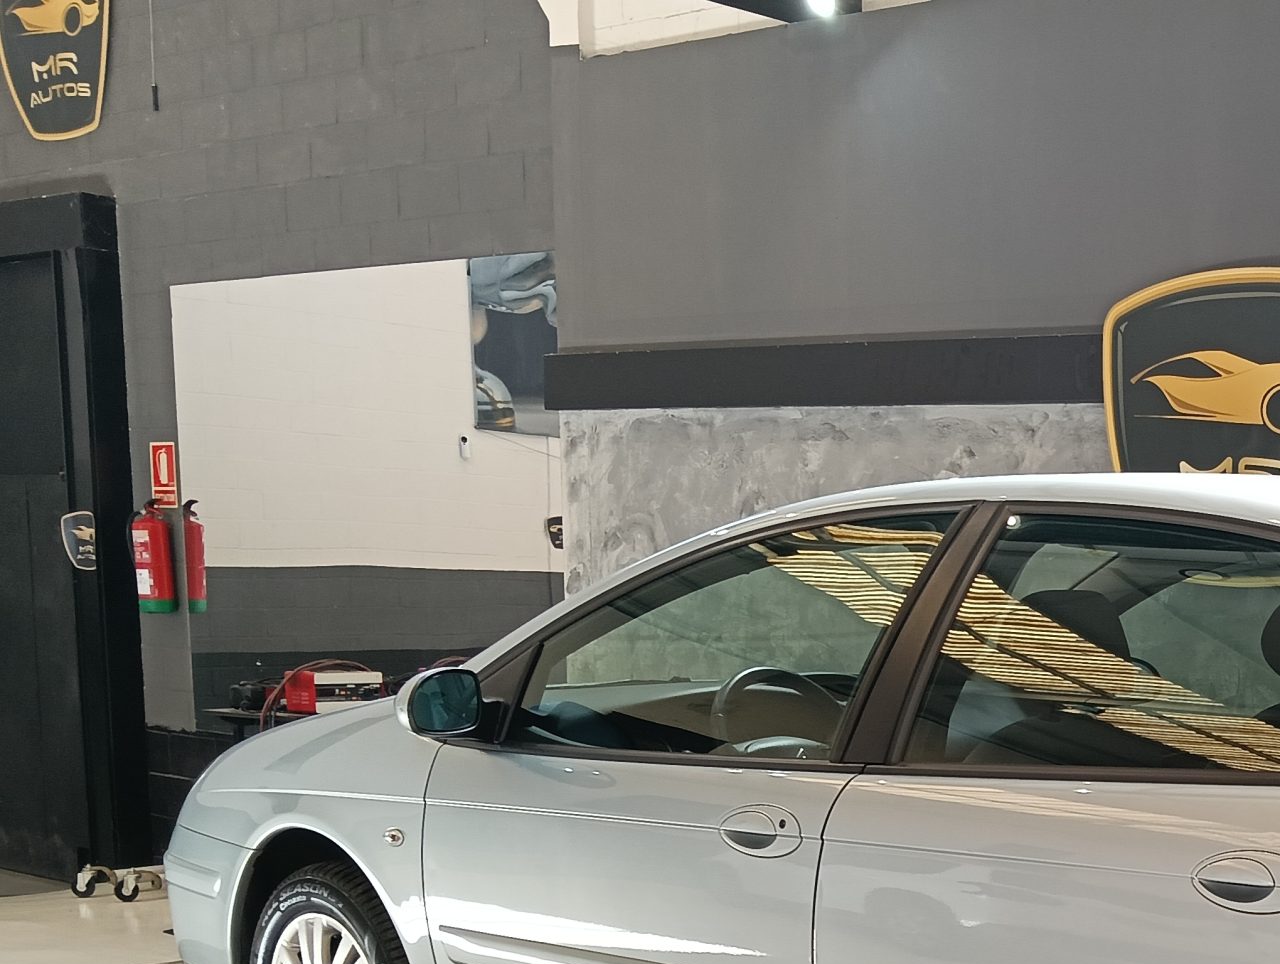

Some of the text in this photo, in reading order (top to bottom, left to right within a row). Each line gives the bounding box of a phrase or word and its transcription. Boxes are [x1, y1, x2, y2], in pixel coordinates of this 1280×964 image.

[31, 52, 78, 83] MR
[30, 82, 91, 108] AUTOS
[278, 882, 330, 901] SEASON
